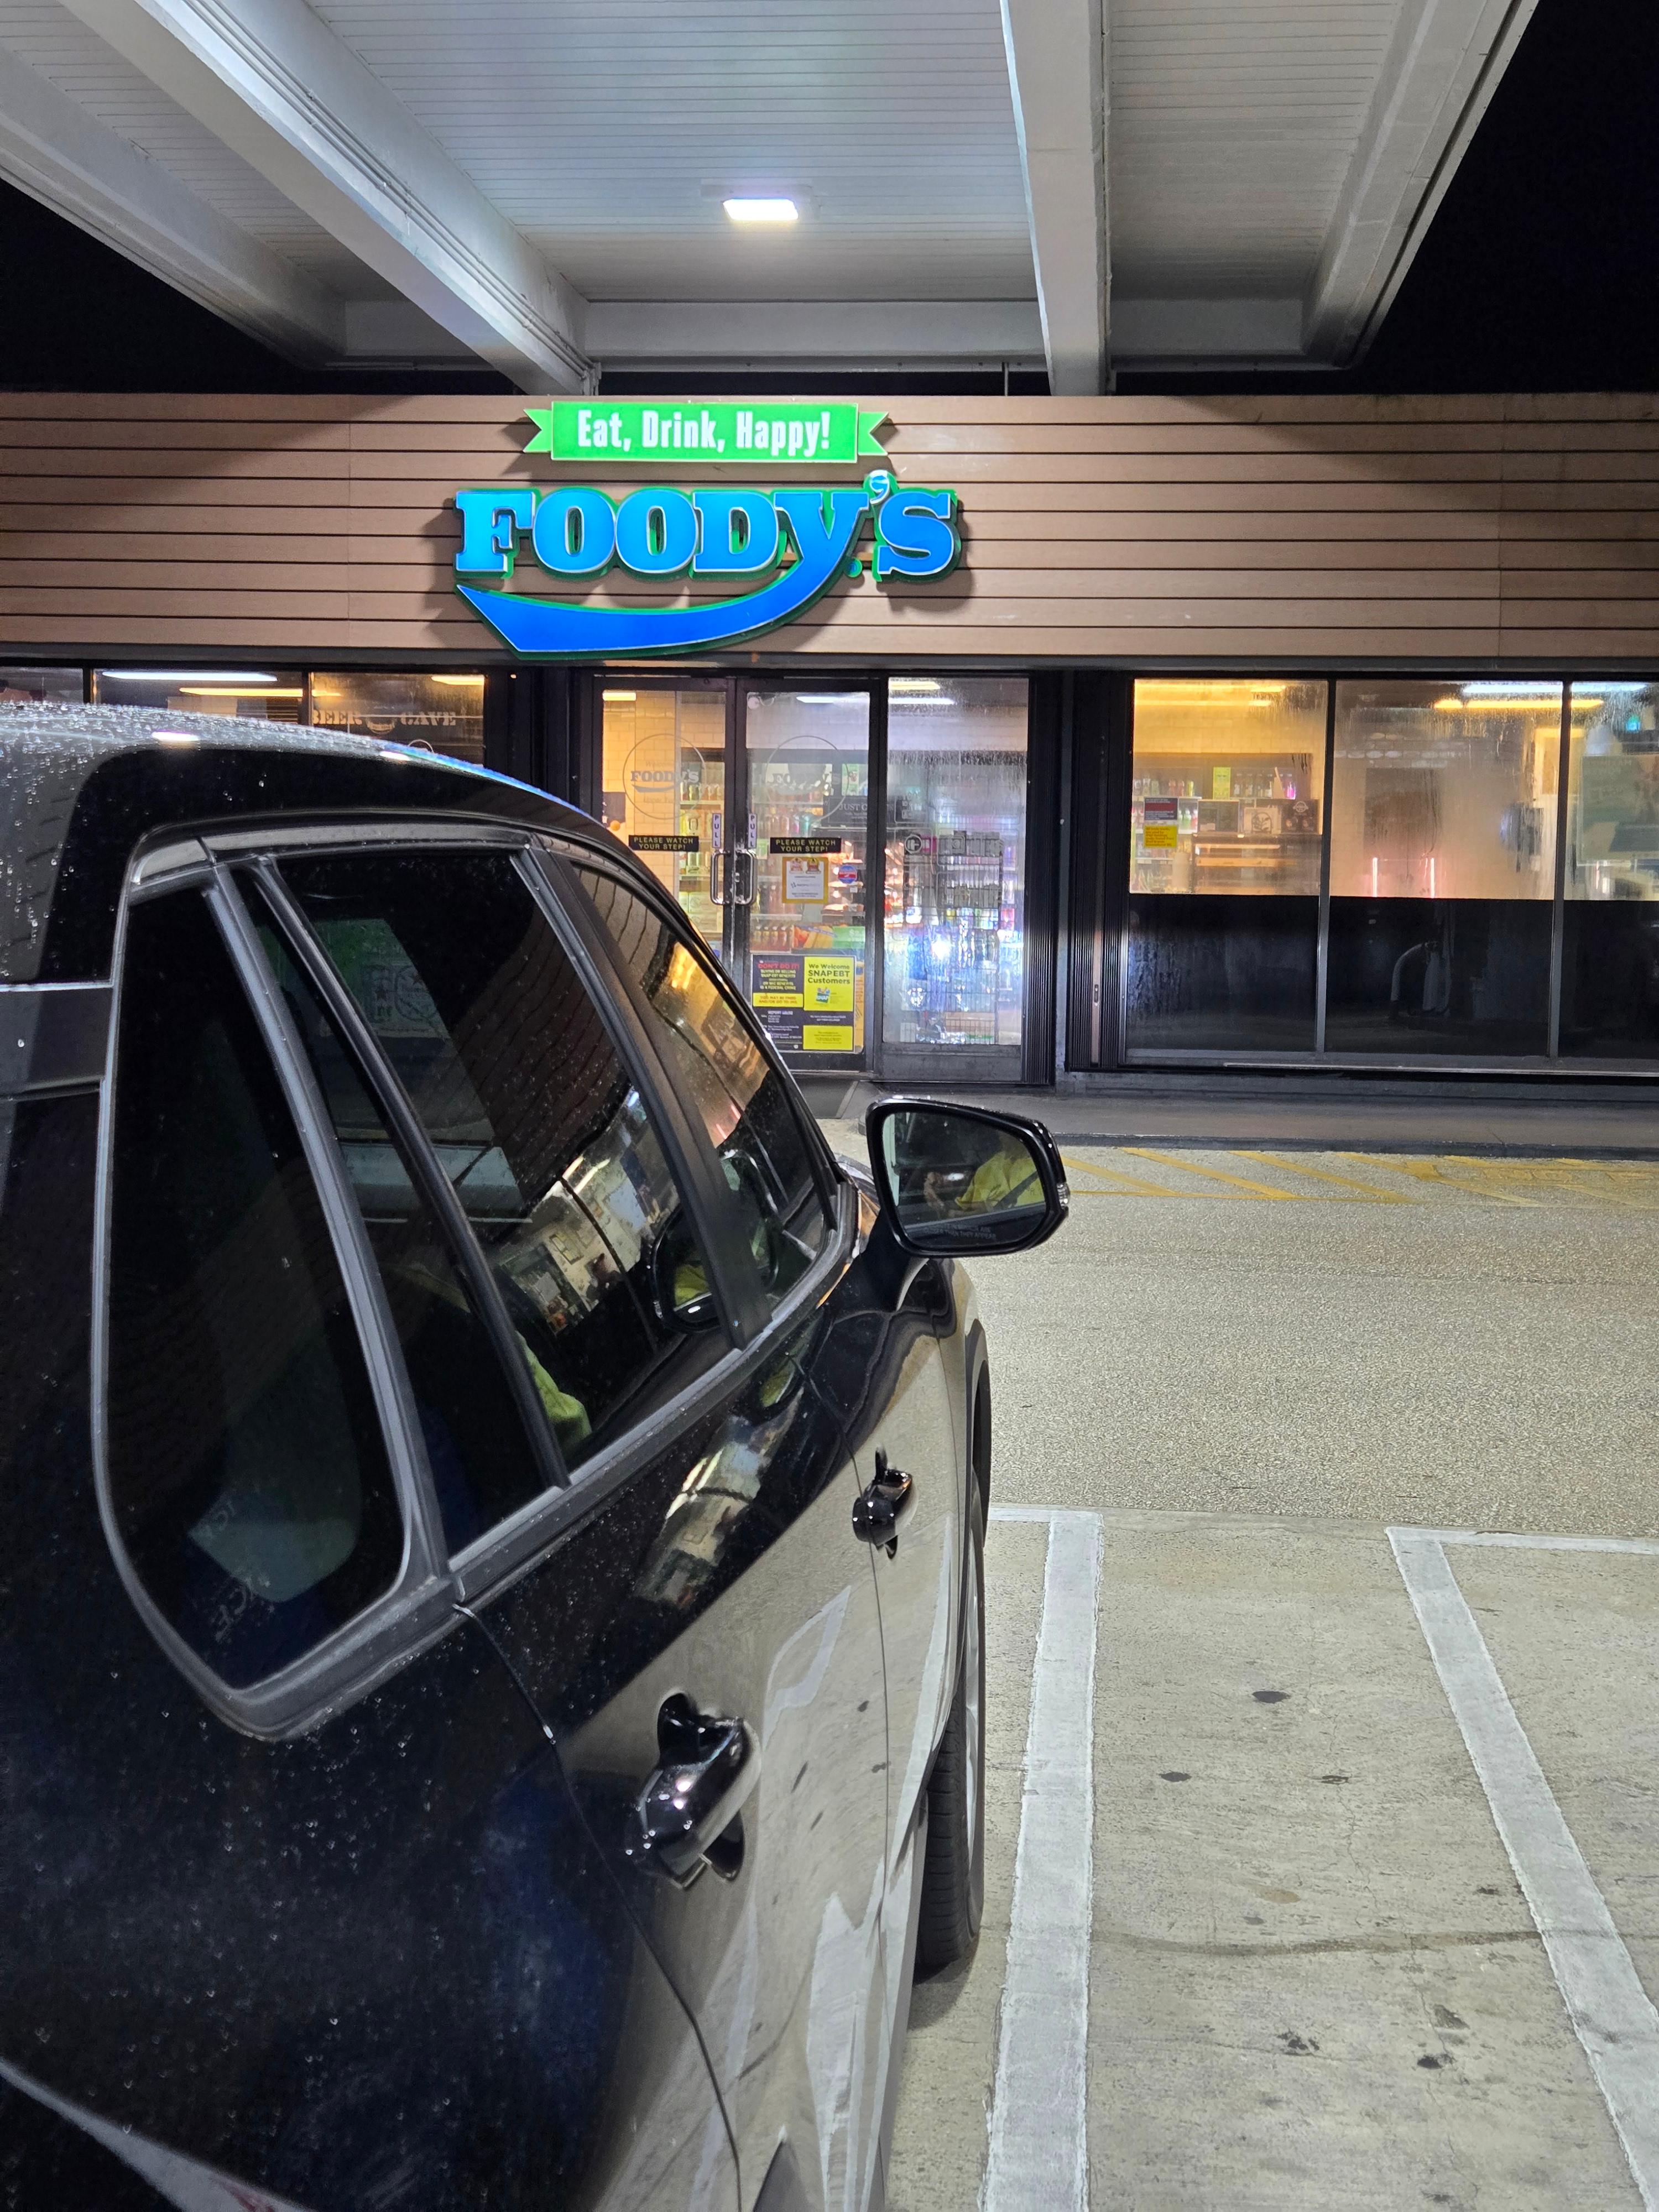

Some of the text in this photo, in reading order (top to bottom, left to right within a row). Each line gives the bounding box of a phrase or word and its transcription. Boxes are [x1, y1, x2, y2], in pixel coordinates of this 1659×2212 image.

[577, 410, 830, 457] Eat, Drink, Happy!
[455, 470, 957, 653] FOODY'S
[401, 711, 456, 726] CAVE
